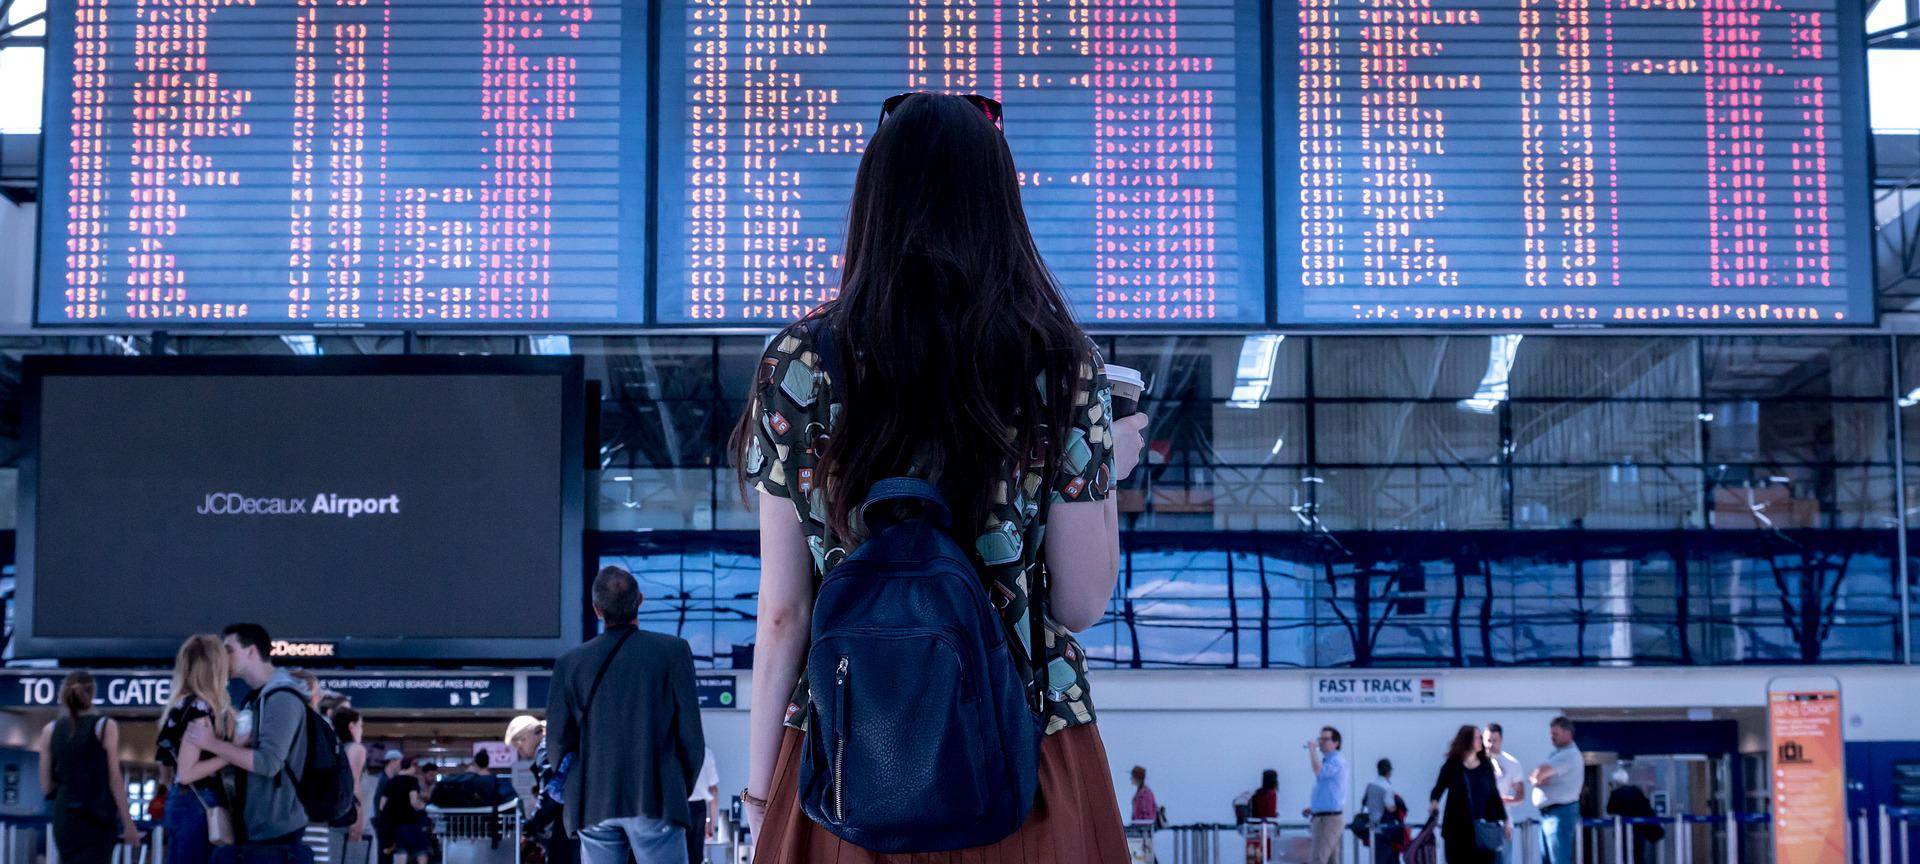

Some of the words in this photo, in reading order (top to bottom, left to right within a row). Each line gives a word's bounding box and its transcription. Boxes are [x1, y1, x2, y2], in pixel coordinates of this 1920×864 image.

[197, 493, 306, 514] JCDecaux
[311, 494, 400, 517] Airport
[19, 678, 54, 704] TO
[108, 679, 172, 704] GATE
[328, 680, 348, 689] YOUR
[350, 680, 387, 689] PASSPORT
[388, 680, 404, 689] AND
[405, 680, 443, 689] BOARDING
[445, 680, 463, 689] PASS
[464, 680, 490, 689] READY
[1319, 679, 1355, 692] FAST
[1361, 679, 1412, 692] TRACK
